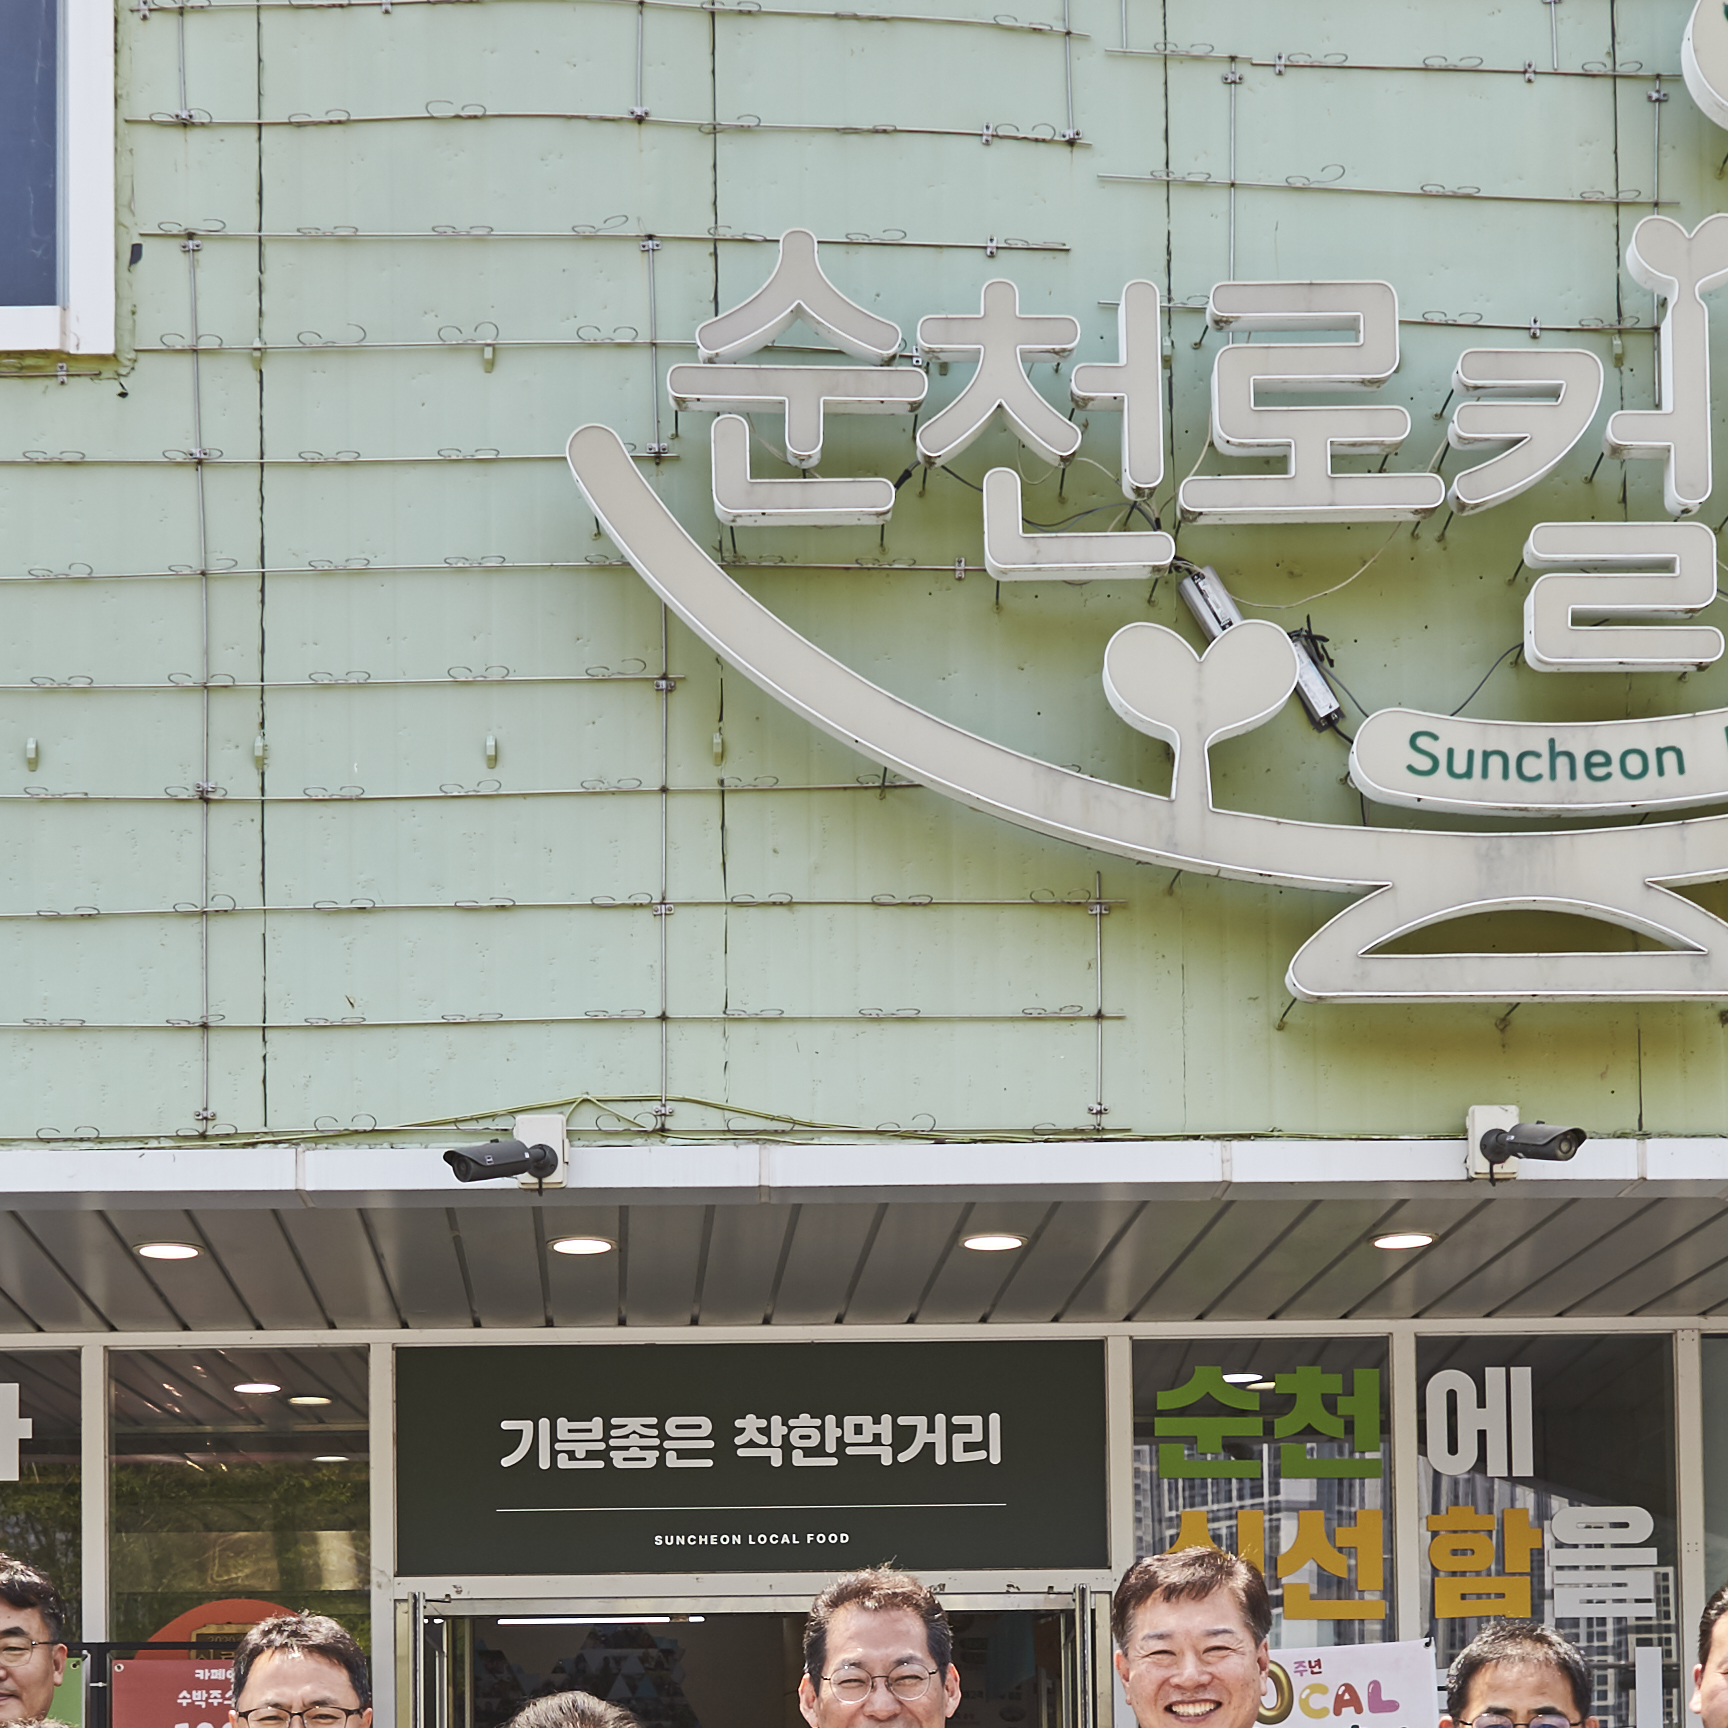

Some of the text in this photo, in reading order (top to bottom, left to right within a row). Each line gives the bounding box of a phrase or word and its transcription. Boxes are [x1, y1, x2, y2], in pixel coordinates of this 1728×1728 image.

[1405, 728, 1686, 784] Suncheon
[499, 1411, 1003, 1471] 기분좋은 착한먹거리
[653, 1532, 850, 1546] SUNCHEON LOCAL FOOD
[1293, 1658, 1324, 1679] 주년
